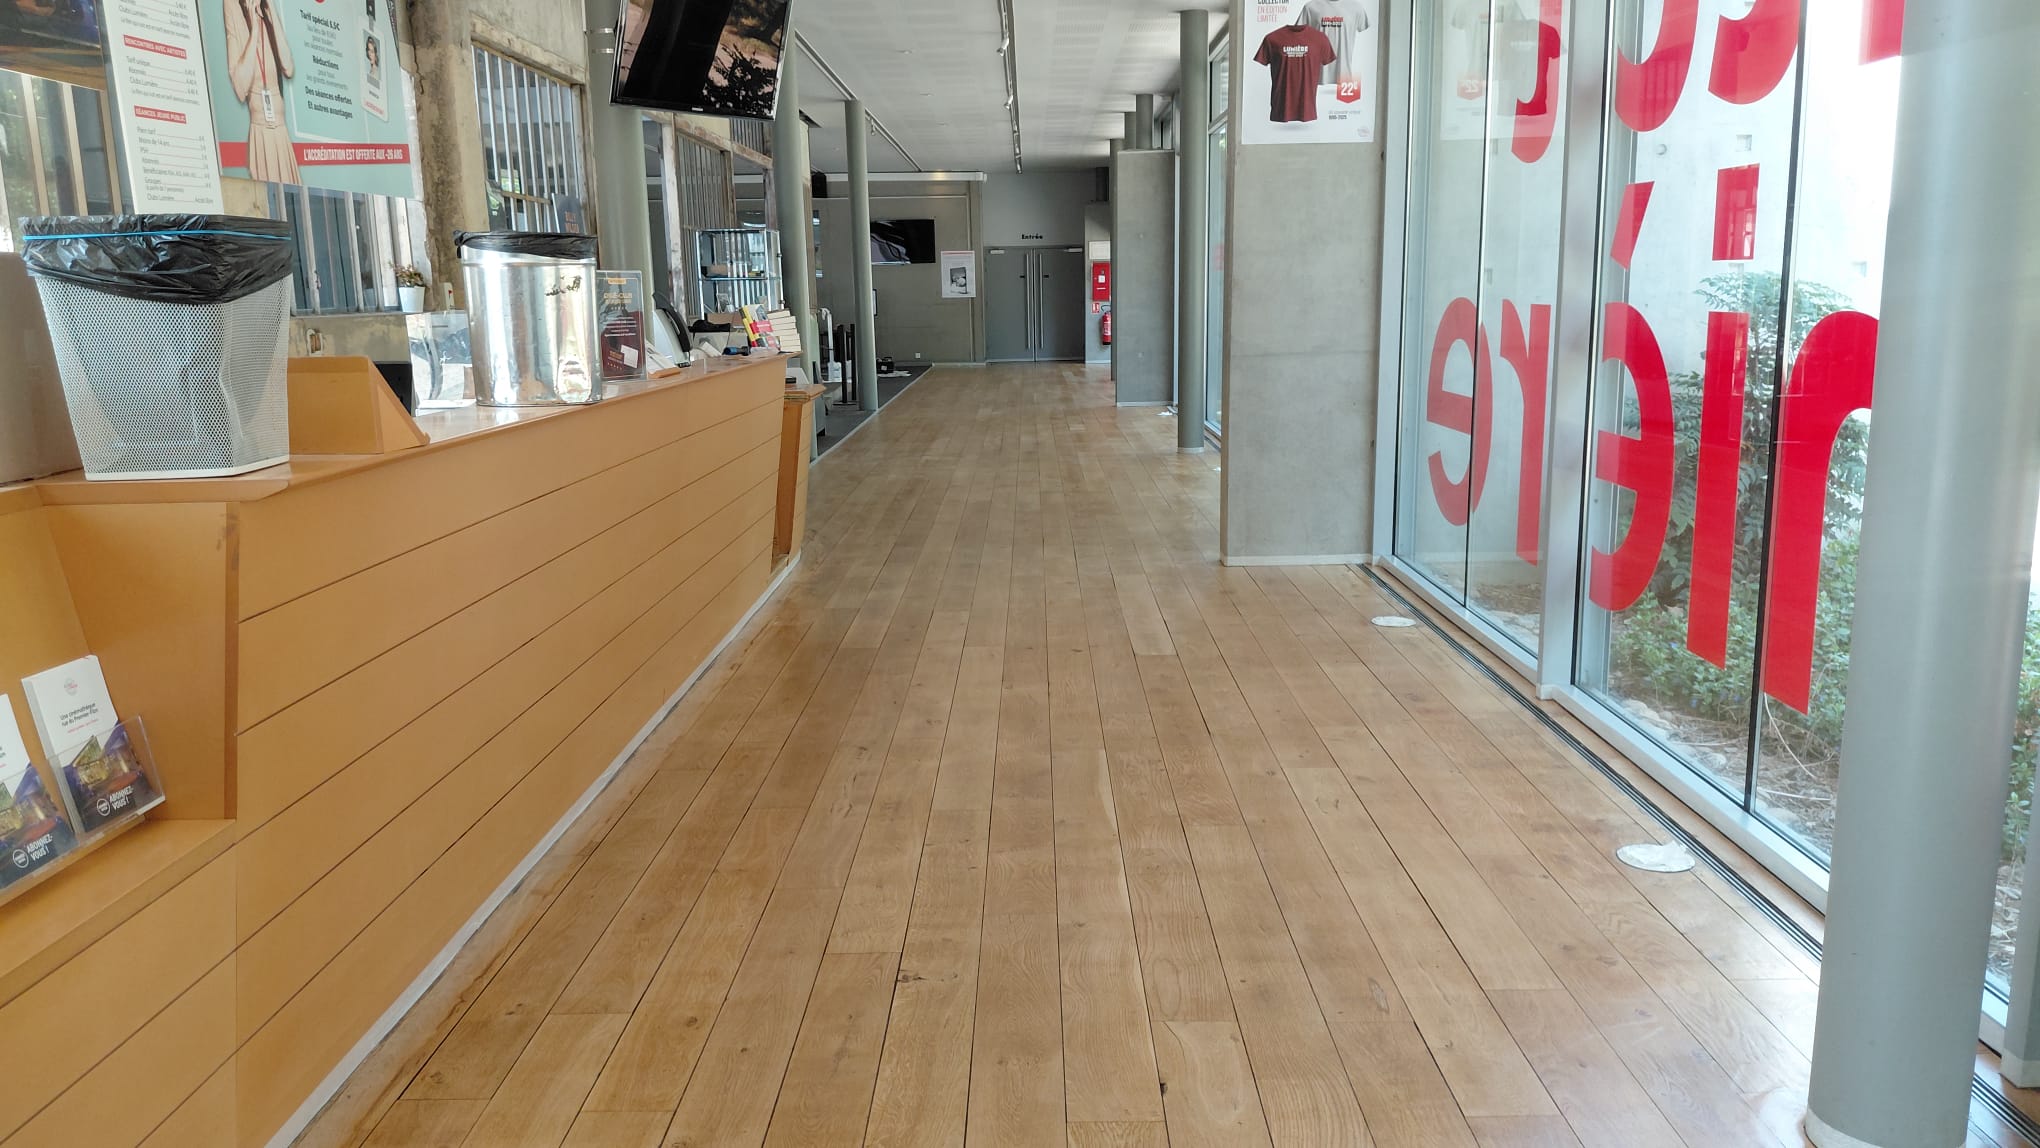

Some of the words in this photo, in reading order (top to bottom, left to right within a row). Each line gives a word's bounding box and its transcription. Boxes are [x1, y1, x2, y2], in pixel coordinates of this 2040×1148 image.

[303, 146, 346, 160] L'ACCRÉDITATION
[346, 149, 355, 160] EST
[355, 149, 375, 160] OFFERTE
[376, 149, 385, 160] AUX
[393, 149, 403, 159] ANS
[109, 785, 134, 802] ABONNEZ-
[112, 798, 127, 810] VOUS
[26, 833, 53, 853] ABONNEZ-
[30, 848, 46, 861] VOUS
